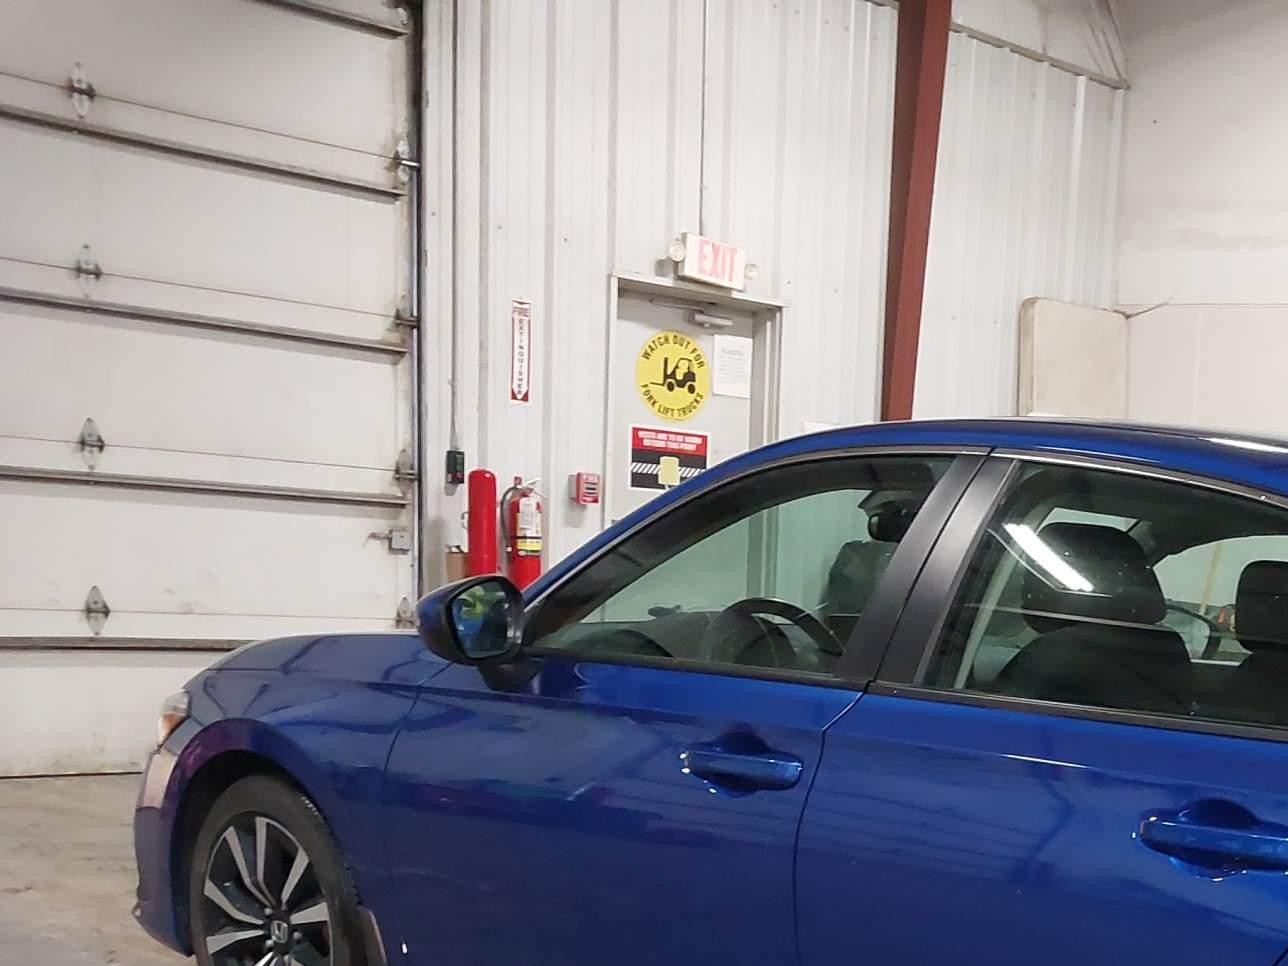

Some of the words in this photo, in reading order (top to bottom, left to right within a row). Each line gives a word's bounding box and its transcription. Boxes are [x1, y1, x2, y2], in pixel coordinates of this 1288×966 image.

[698, 239, 738, 281] EXIT
[641, 334, 671, 361] WATCH
[672, 334, 692, 350] OUT
[690, 347, 706, 369] FOR
[640, 383, 657, 409] FORK
[656, 404, 675, 418] LIFT
[677, 391, 704, 418] TRUCKS
